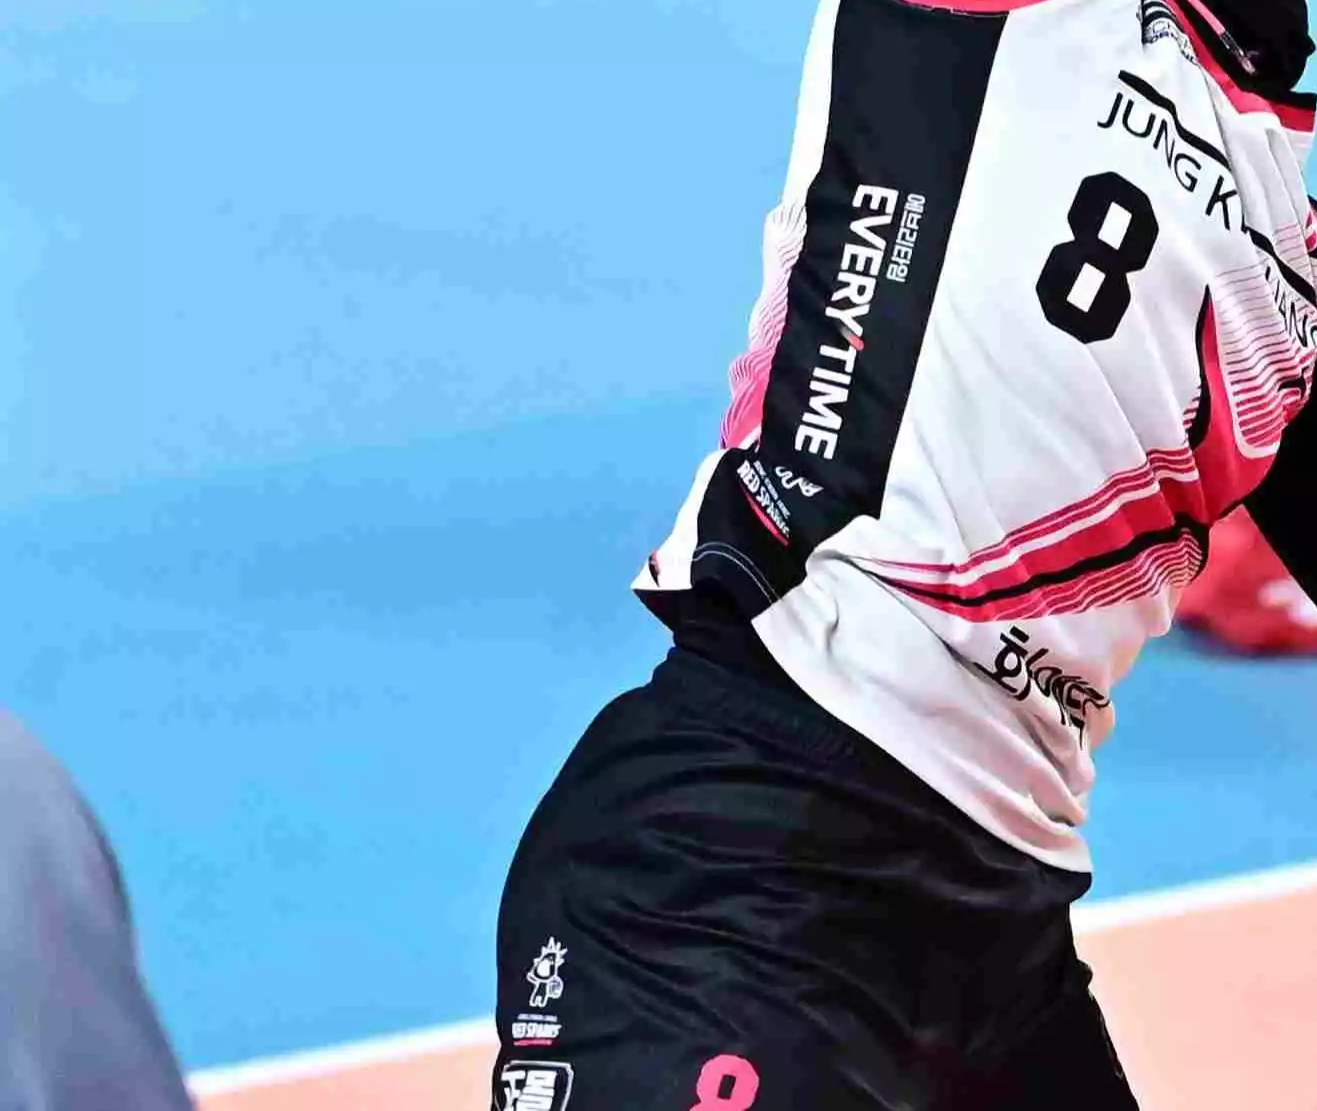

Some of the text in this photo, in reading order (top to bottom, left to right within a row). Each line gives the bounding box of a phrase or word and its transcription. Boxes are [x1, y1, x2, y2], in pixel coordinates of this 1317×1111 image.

[1097, 92, 1202, 193] JUNG
[885, 192, 926, 283] 에브리타임
[1035, 170, 1160, 345] 8
